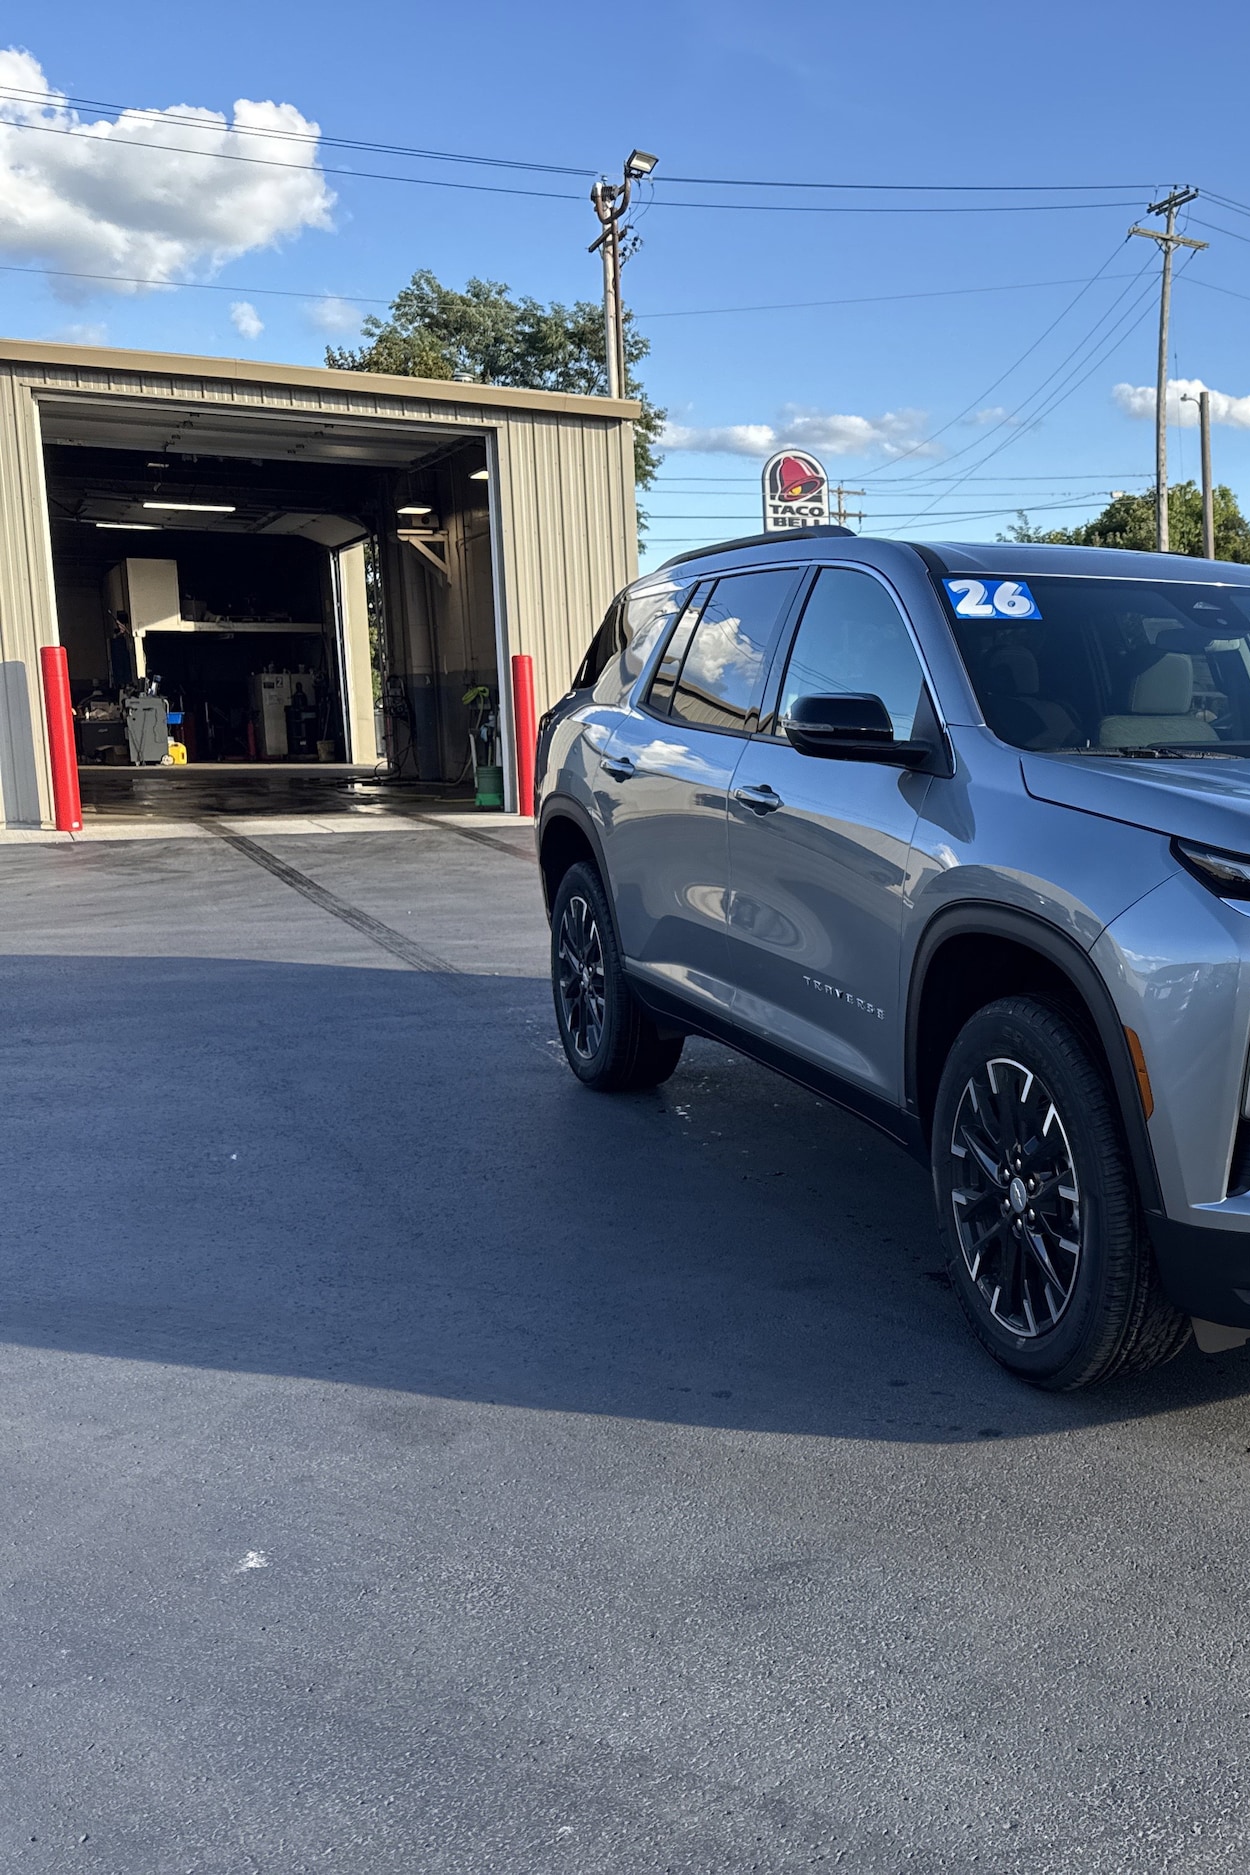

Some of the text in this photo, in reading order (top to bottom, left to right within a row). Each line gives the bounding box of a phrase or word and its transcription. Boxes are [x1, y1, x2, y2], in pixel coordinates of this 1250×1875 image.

[768, 504, 825, 517] TACO
[948, 579, 1035, 617] 26
[803, 975, 885, 1020] TRAVERSE
